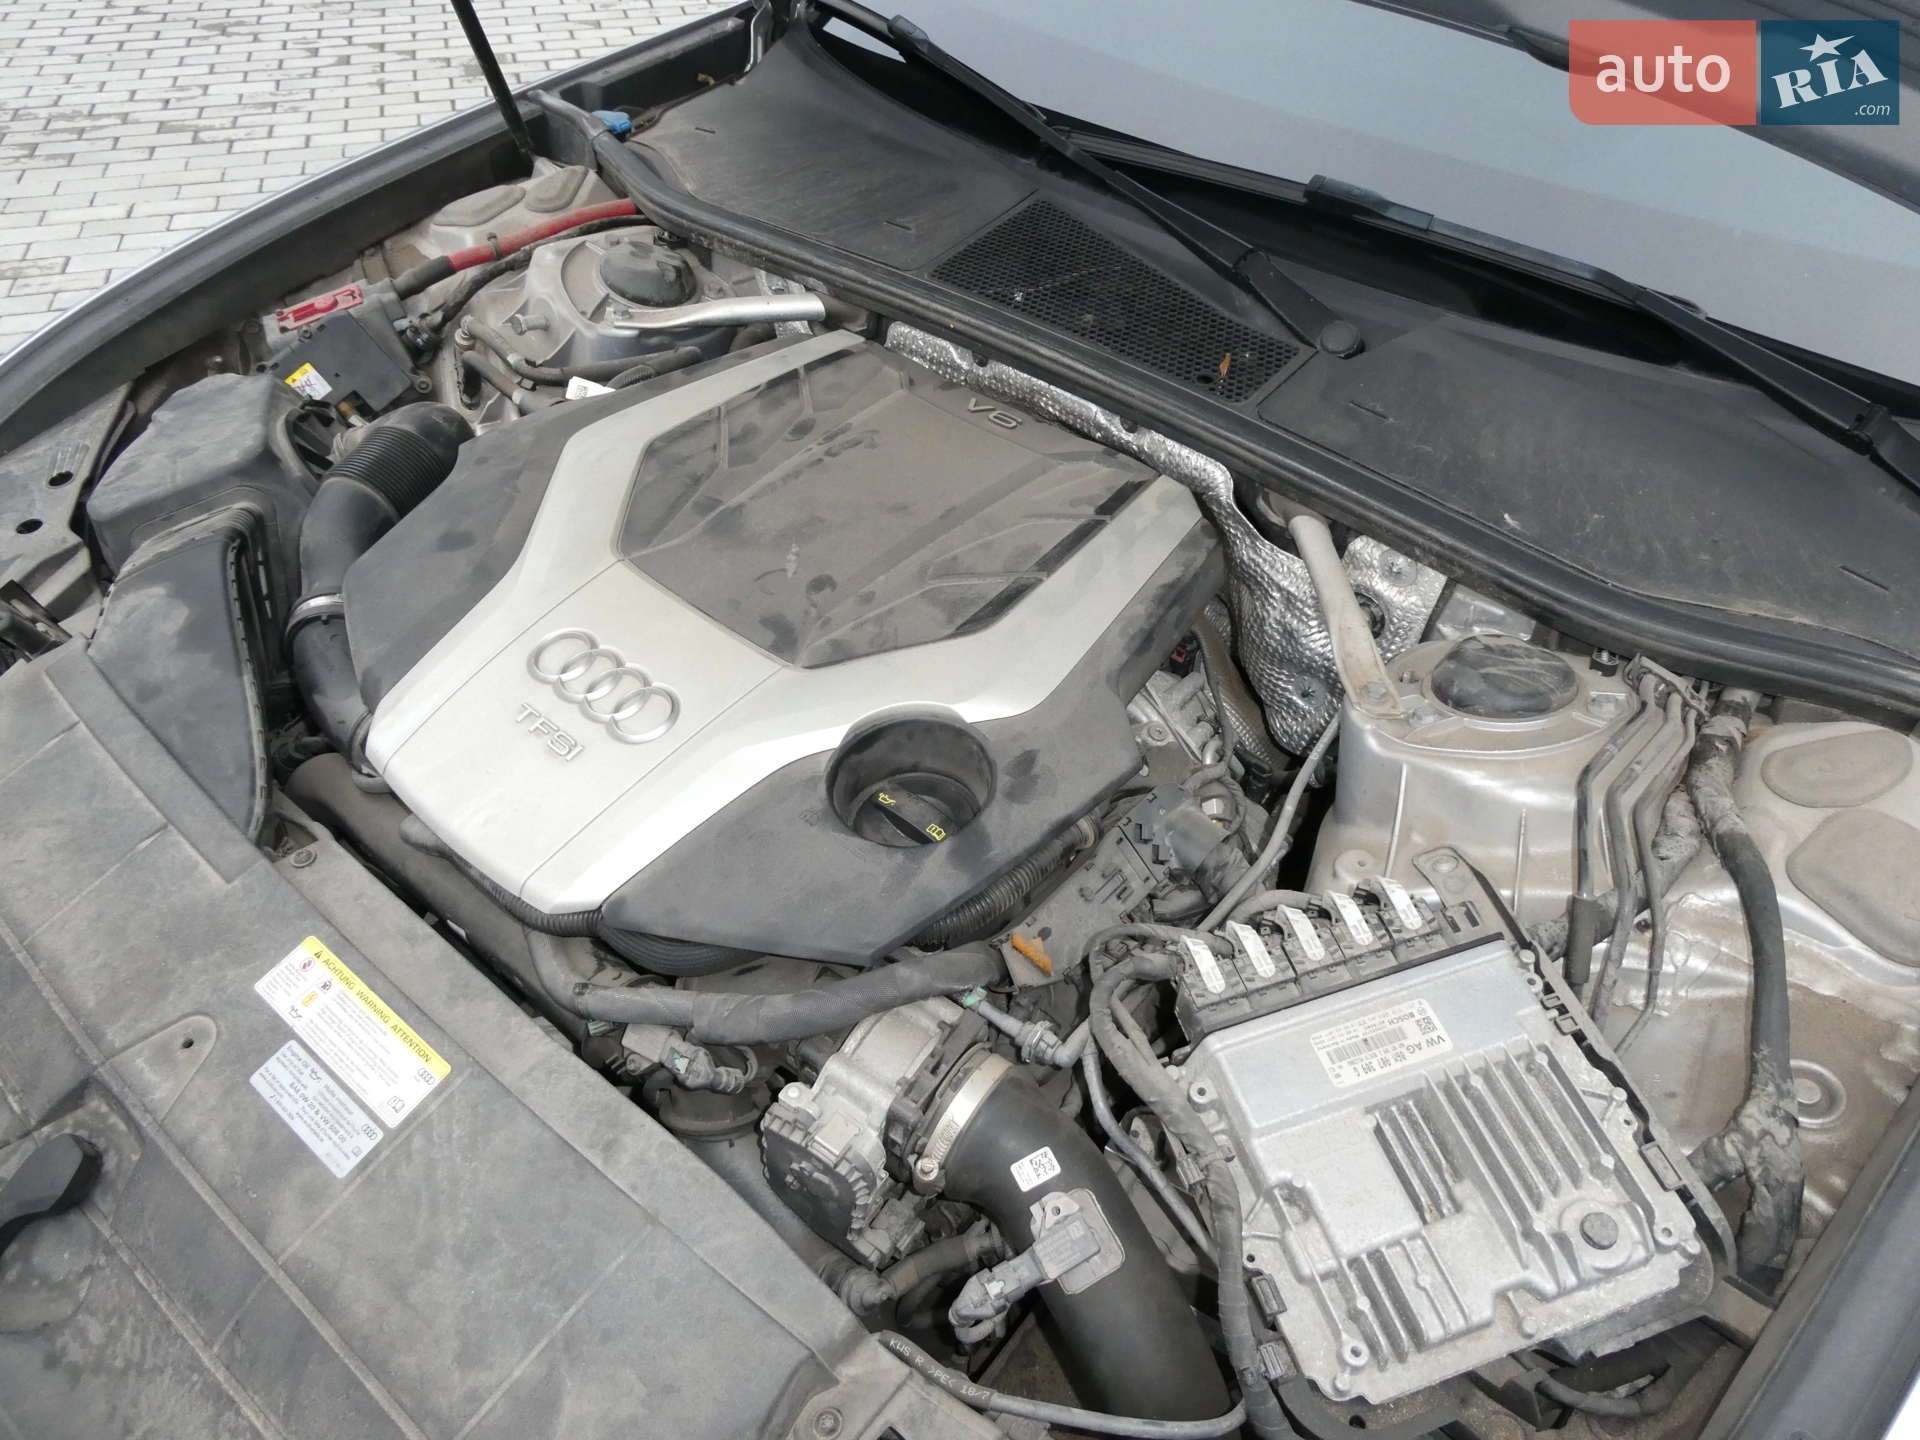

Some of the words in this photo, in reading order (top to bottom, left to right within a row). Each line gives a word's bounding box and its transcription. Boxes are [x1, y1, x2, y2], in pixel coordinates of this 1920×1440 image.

[968, 397, 1022, 430] V6
[516, 702, 585, 762] TFSI
[321, 957, 356, 990] ACHTUNG
[354, 988, 391, 1024] WARNING
[389, 1022, 432, 1063] ATTENTION
[1386, 1011, 1415, 1025] BOSCH
[1404, 1041, 1424, 1054] AG
[1423, 1033, 1445, 1047] VW
[285, 1044, 303, 1063] Engine
[300, 1059, 309, 1069] Oil
[1375, 1055, 1392, 1068] 907
[1390, 1050, 1407, 1063] 06M
[1352, 1066, 1361, 1076] G
[1359, 1060, 1376, 1074] 309
[322, 1083, 337, 1098] Huile
[334, 1095, 354, 1116] moteur
[288, 1081, 301, 1094] SAE
[318, 1113, 330, 1126] VW
[328, 1123, 340, 1136] 508
[337, 1133, 347, 1143] 00
[889, 1338, 911, 1357] KWS
[915, 1355, 924, 1367] R
[928, 1365, 956, 1388] >PE<
[960, 1384, 990, 1400] 18/7
